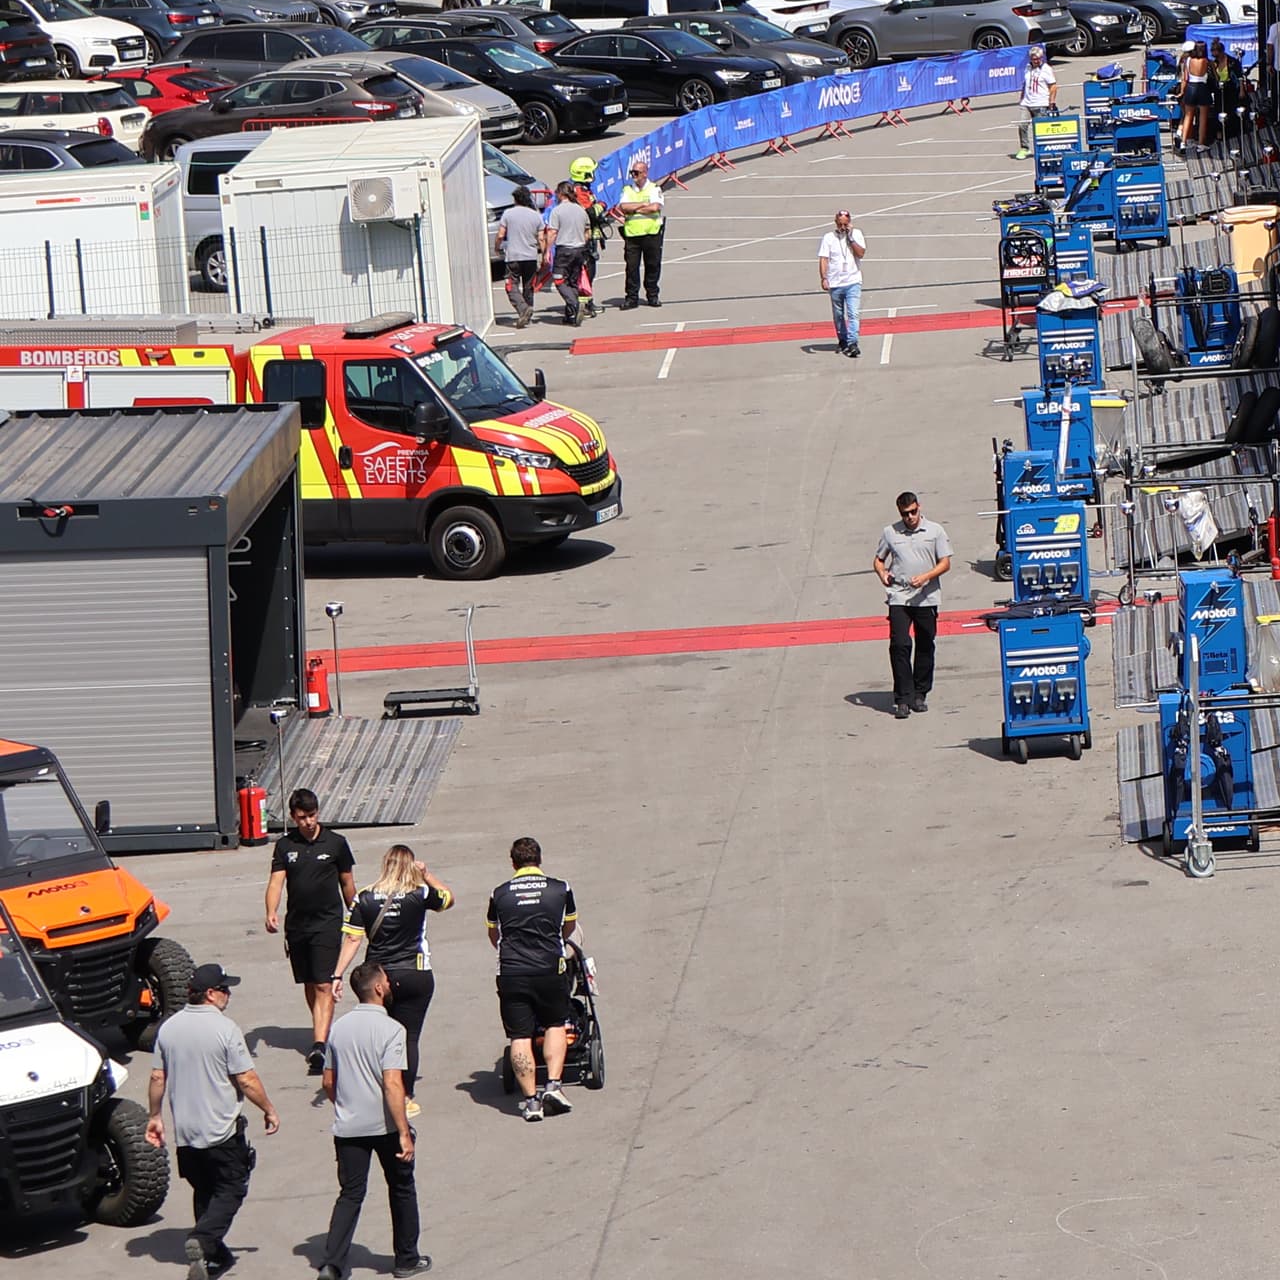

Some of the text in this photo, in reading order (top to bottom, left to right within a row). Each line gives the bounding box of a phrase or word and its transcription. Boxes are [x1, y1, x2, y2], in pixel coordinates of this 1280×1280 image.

[988, 66, 1015, 78] DUCATI
[1116, 173, 1132, 182] 47
[20, 350, 120, 366] BOMBEROS
[363, 456, 427, 471] SAFETY
[366, 470, 427, 484] EVENTS
[1191, 607, 1237, 620] MotoE
[1019, 664, 1067, 677] MotoE
